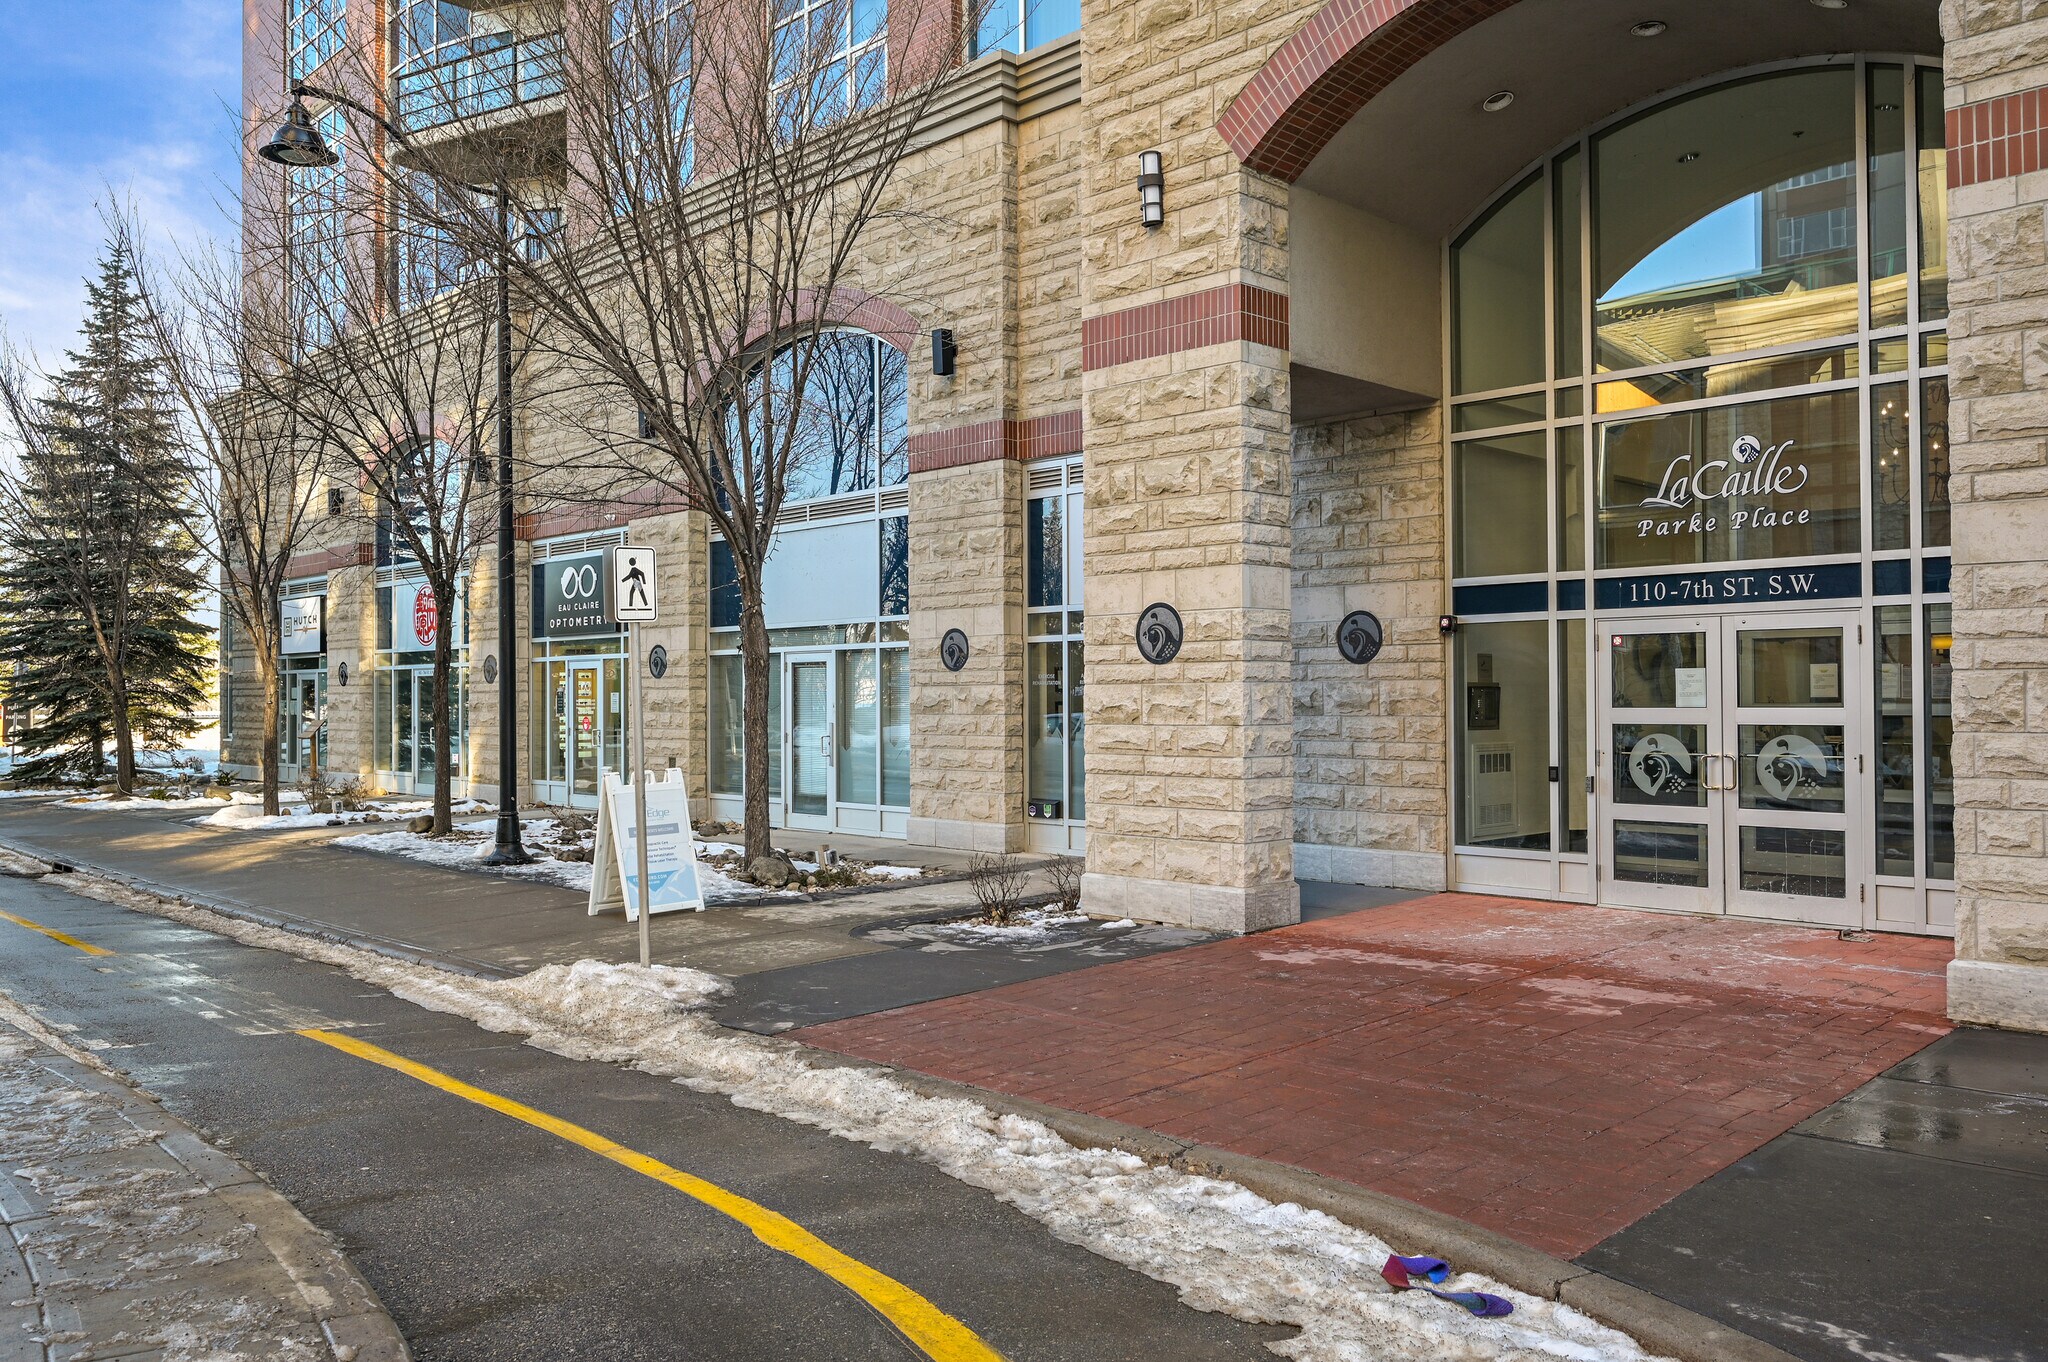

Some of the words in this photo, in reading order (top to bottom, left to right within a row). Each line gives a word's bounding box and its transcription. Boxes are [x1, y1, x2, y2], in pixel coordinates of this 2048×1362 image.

[1636, 512, 1717, 538] Parke
[1731, 506, 1811, 530] Place
[1630, 579, 1714, 603] 110-7th
[1723, 576, 1759, 598] ST.
[1769, 573, 1819, 596] S.W.
[558, 602, 571, 612] EAU
[574, 601, 599, 611] CLAIRE
[293, 615, 317, 625] HUTCH
[647, 808, 670, 818] Edge
